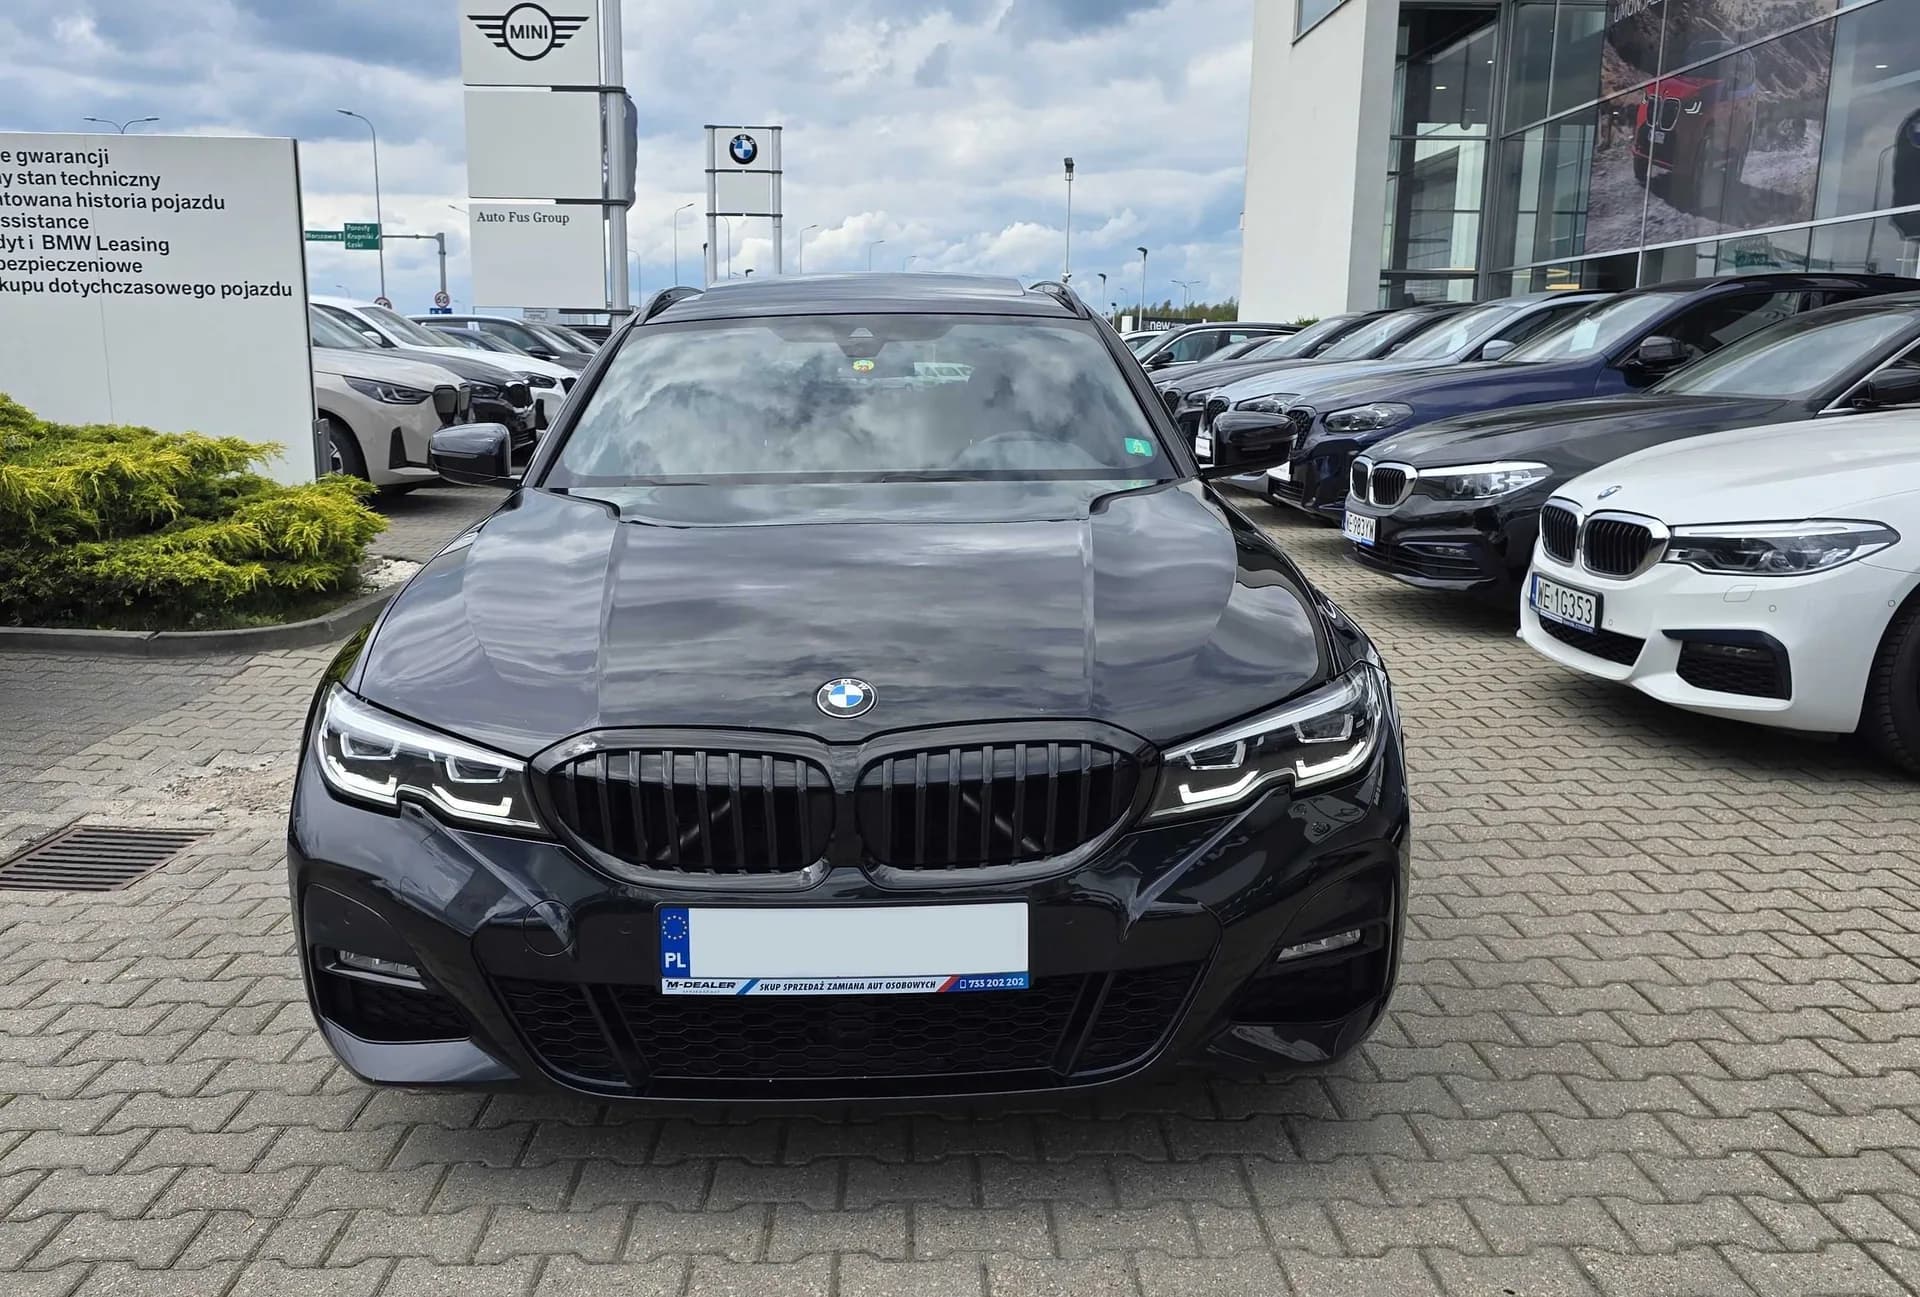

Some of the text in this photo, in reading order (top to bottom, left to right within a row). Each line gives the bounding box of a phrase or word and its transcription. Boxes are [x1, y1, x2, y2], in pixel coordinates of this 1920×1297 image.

[510, 25, 548, 39] MINI
[16, 148, 109, 168] gwarancji
[17, 170, 57, 186] stan
[60, 170, 161, 191] techniczny
[76, 191, 147, 209] historia
[151, 194, 225, 213] pojazdu
[0, 212, 89, 230] ssistance
[477, 211, 570, 226] Auto Fus Group
[28, 234, 34, 250] i
[42, 234, 92, 251] BMW
[96, 235, 170, 258] Leasing
[0, 276, 293, 300] kupu dotychczasowego pojazdu
[1150, 321, 1171, 330] new
[1554, 587, 1593, 624] 1G353
[665, 952, 687, 968] PL
[760, 983, 781, 991] SKUP
[782, 980, 825, 991] SPRZEDAŻ
[827, 982, 865, 991] ZAMIANA
[867, 982, 884, 990] AUT
[885, 980, 936, 989] OSOBOWYCH
[986, 978, 1005, 987] 202
[1006, 977, 1025, 986] 202
